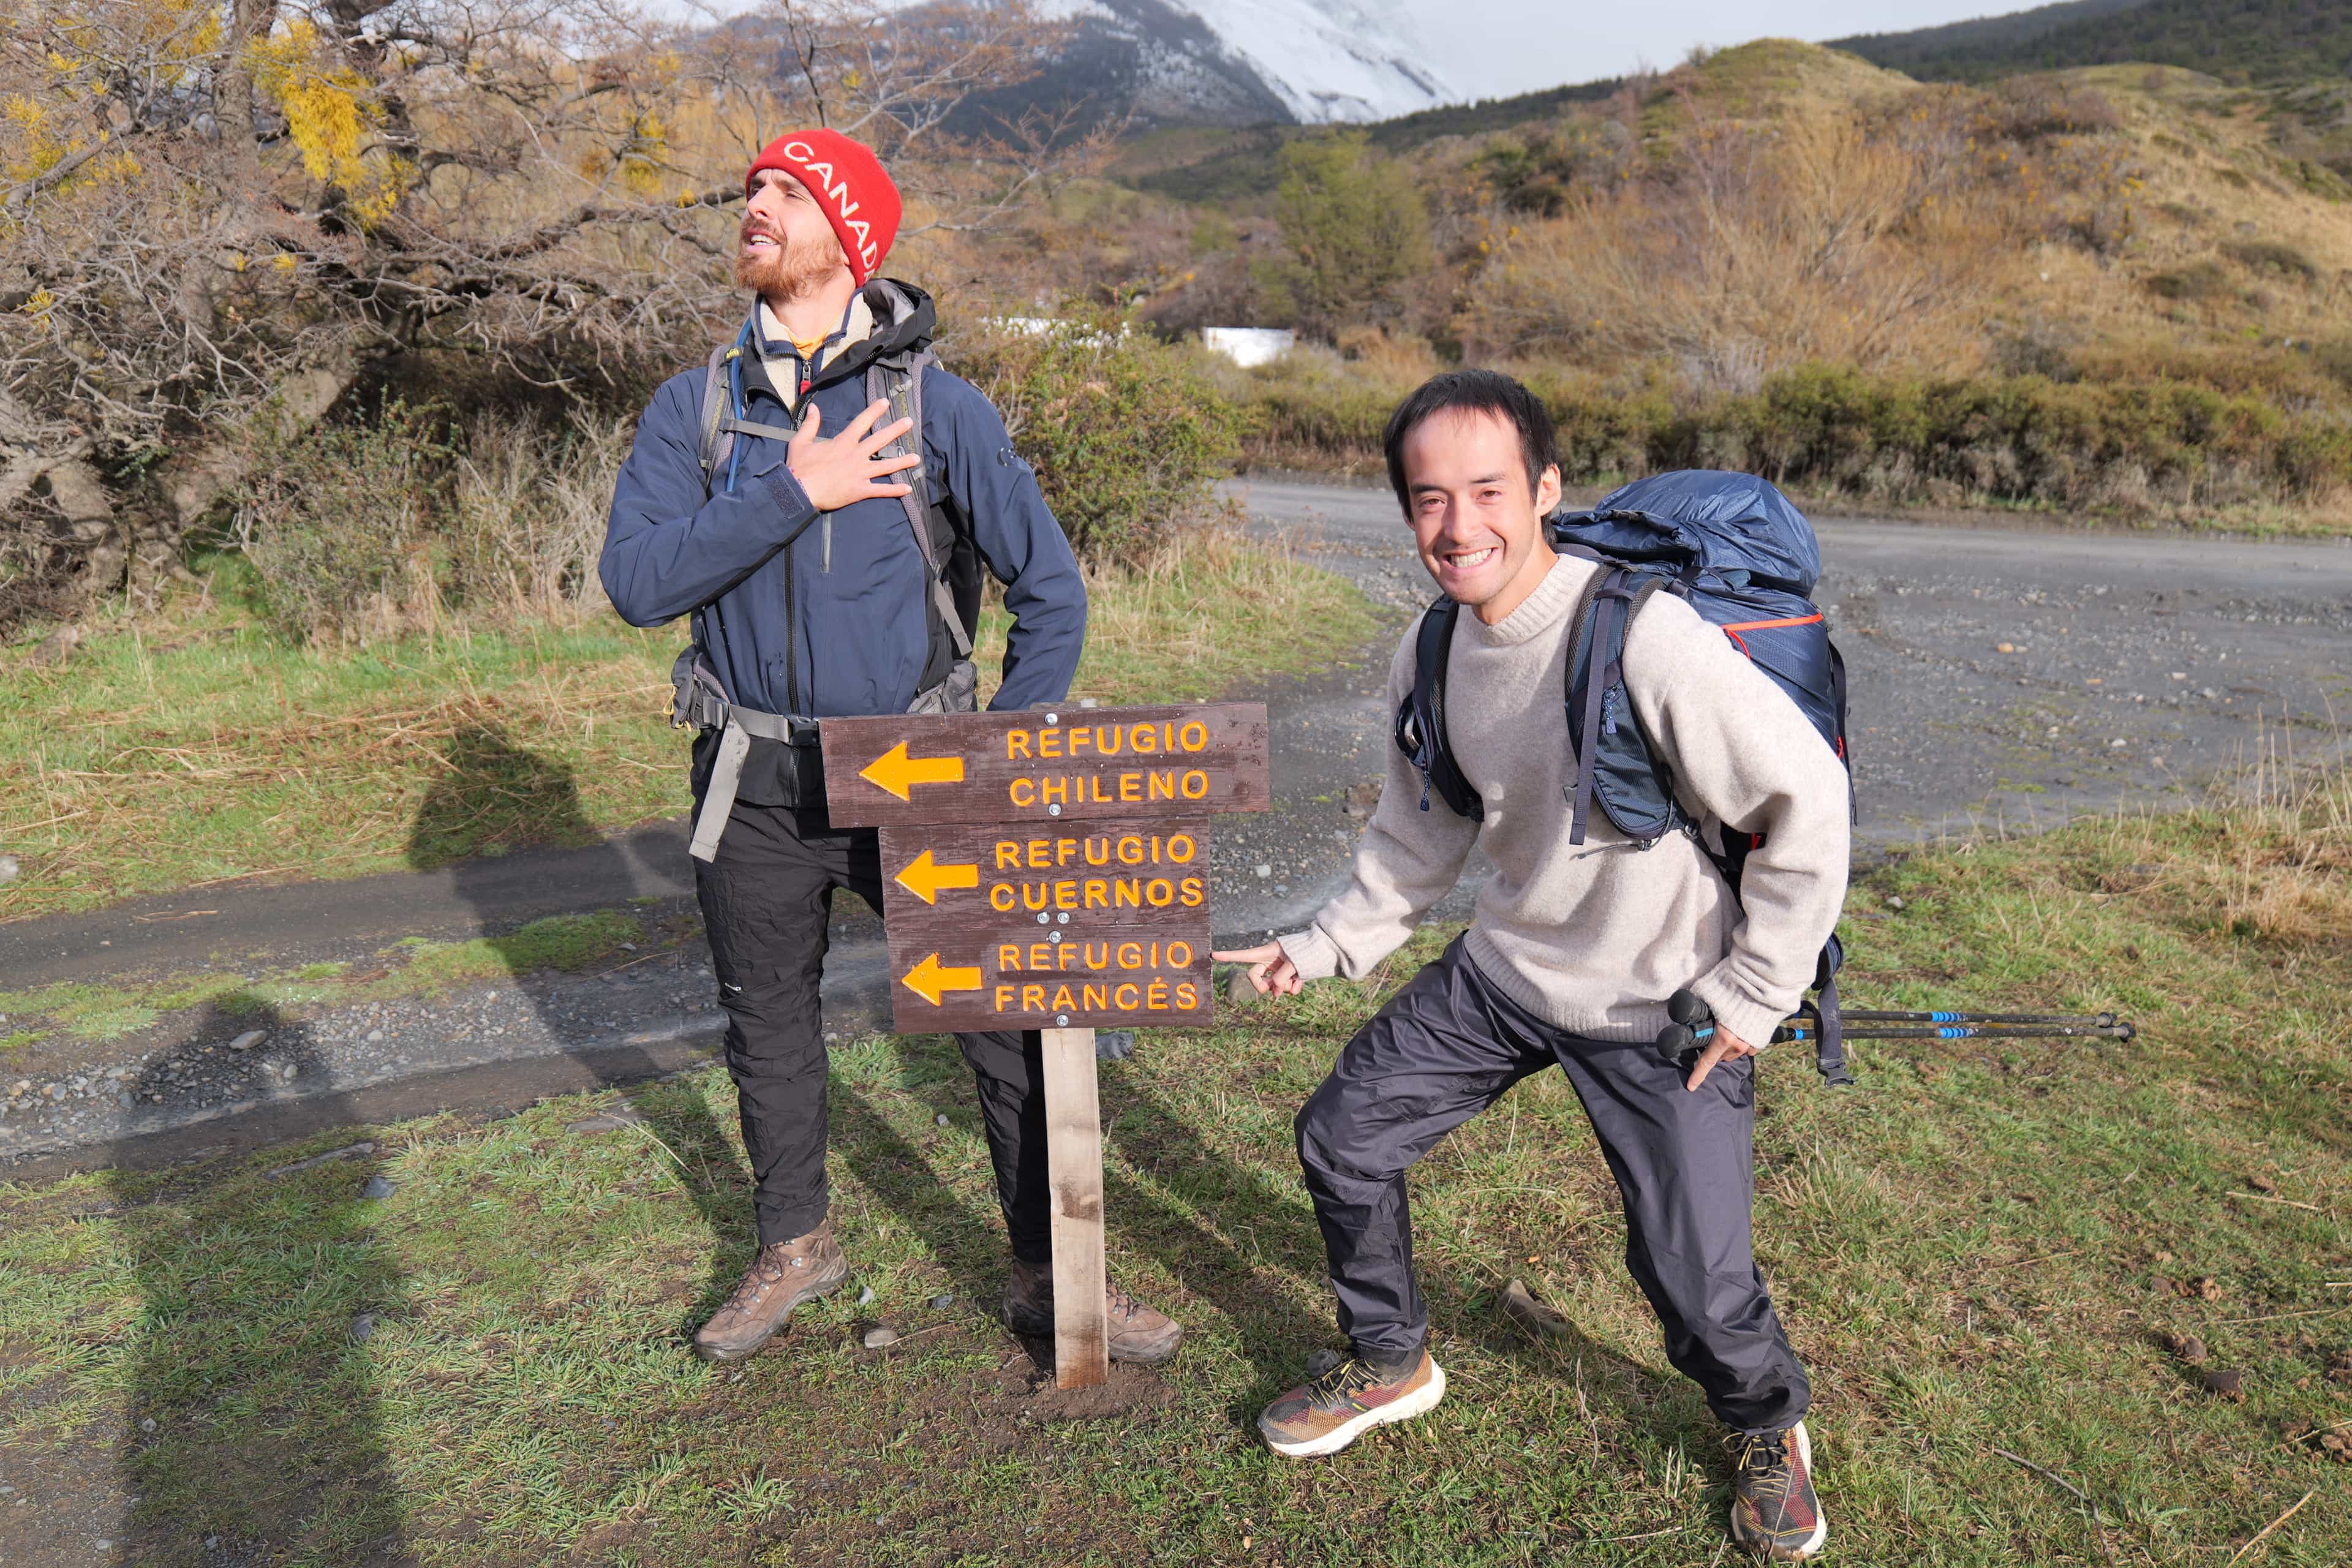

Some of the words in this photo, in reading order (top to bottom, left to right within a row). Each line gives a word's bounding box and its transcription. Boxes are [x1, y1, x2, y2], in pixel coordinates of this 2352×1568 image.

[1007, 721, 1208, 760] REFUGIO
[1009, 770, 1210, 807] CHILENO
[994, 834, 1197, 870] REFUGIO
[989, 876, 1205, 913] CUERNOS
[998, 940, 1194, 972] REFUGIO
[994, 976, 1199, 1014] FRANCÉS
